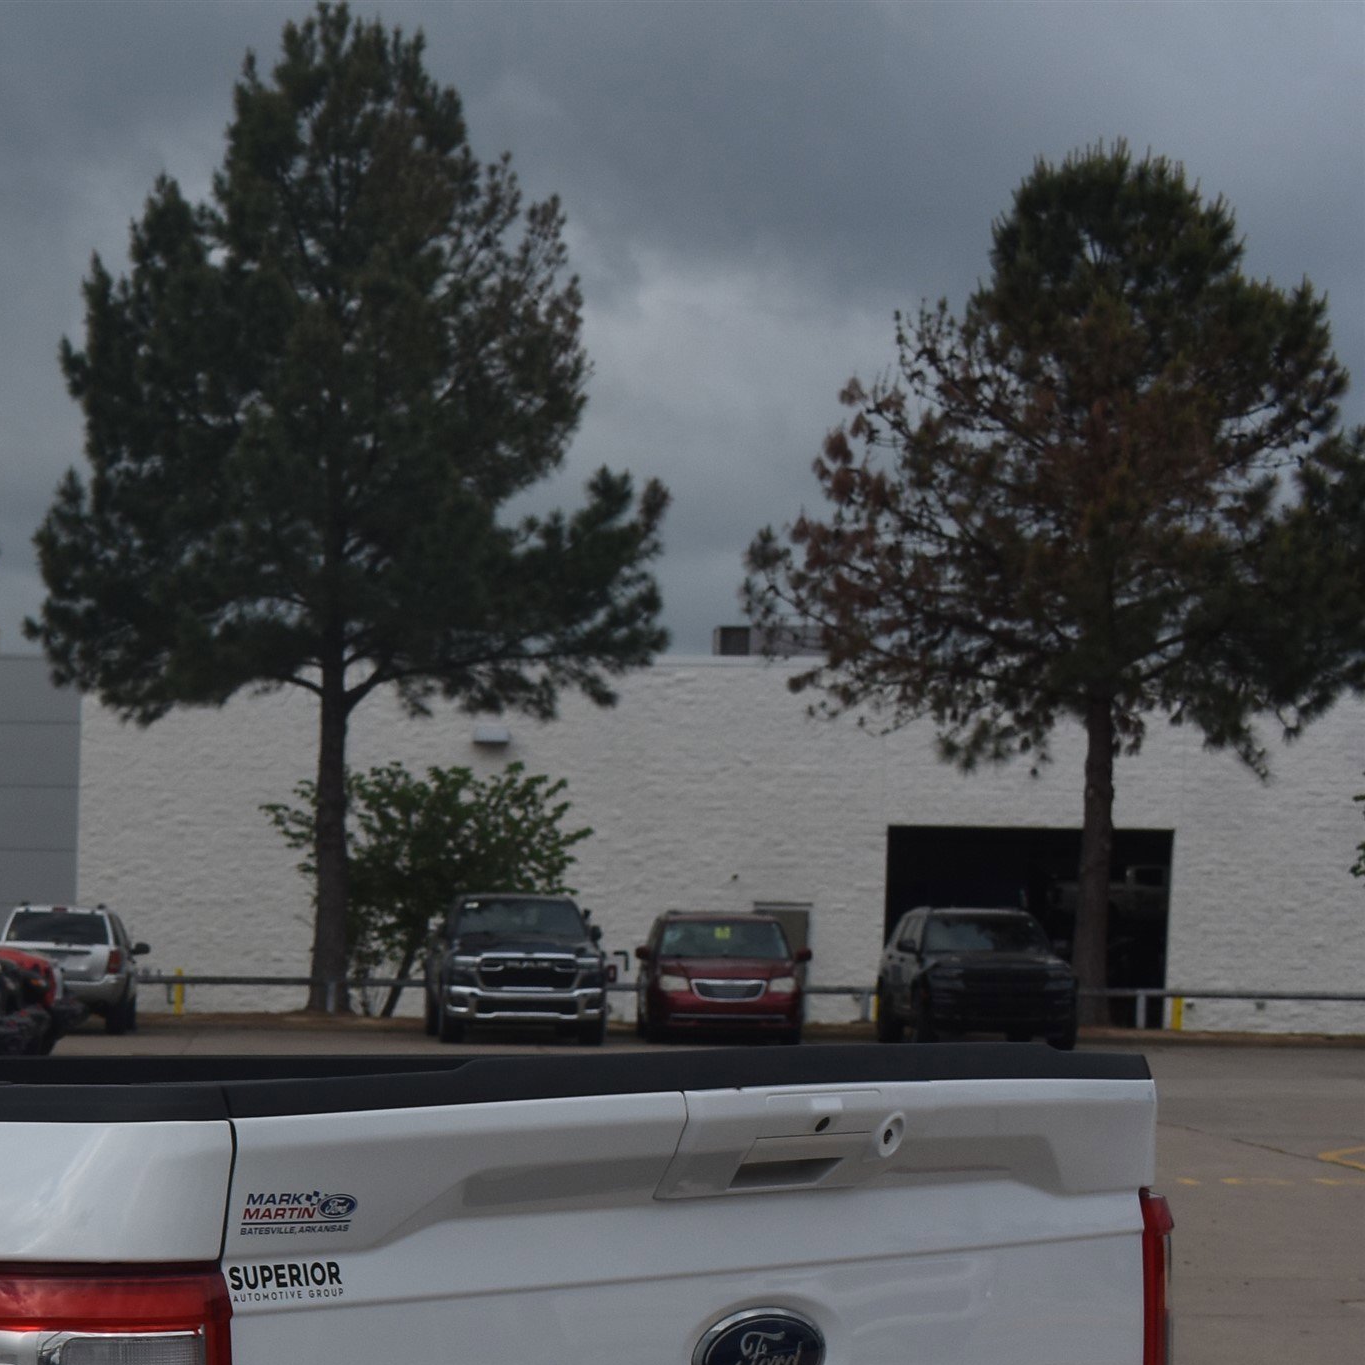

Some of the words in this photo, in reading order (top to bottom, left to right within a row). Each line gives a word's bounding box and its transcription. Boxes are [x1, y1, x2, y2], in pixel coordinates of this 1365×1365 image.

[246, 1193, 305, 1206] MARK
[243, 1207, 317, 1220] MARTIN
[240, 1226, 297, 1236] BATESVILLE,
[297, 1224, 350, 1234] ARKANSAS
[228, 1261, 343, 1291] SUPERIOR
[233, 1290, 302, 1303] AUTOMOTIVE
[308, 1287, 344, 1299] GROUP
